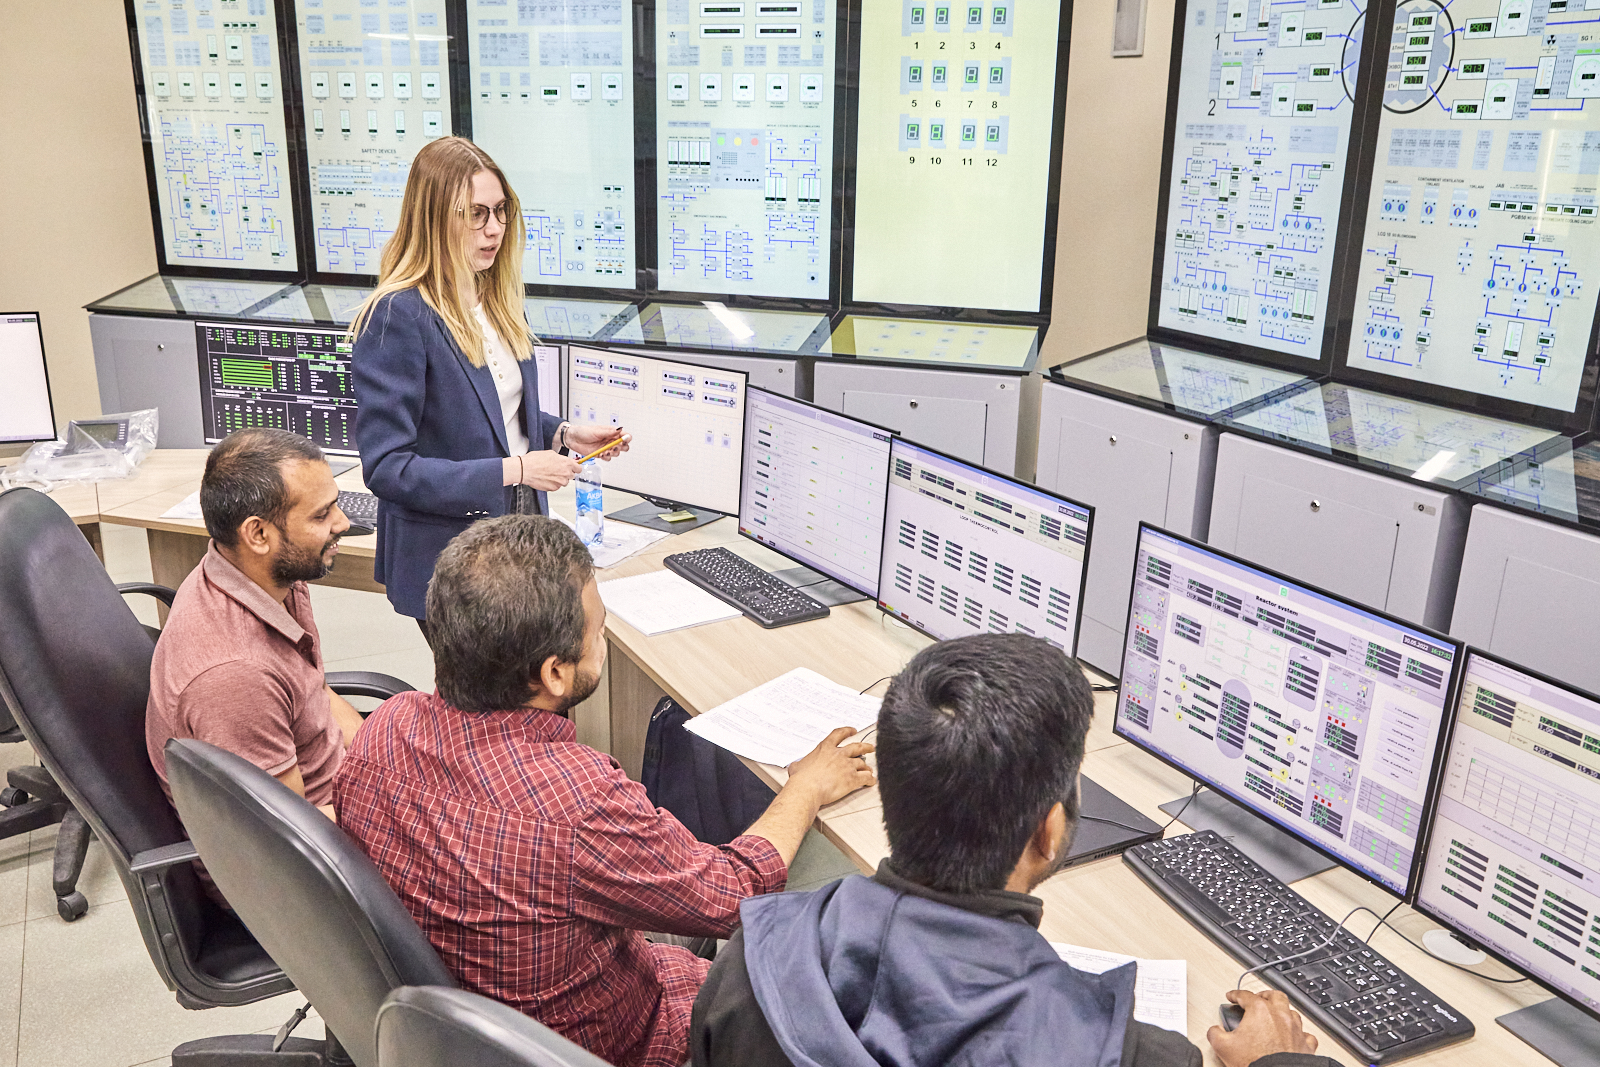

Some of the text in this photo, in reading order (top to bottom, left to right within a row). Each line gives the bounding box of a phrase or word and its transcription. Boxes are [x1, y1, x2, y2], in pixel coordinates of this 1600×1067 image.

[914, 42, 1001, 50] 1 2 3 4
[1215, 33, 1220, 50] 1
[992, 101, 998, 109] 8
[1208, 99, 1216, 116] 2
[930, 157, 941, 165] 10
[1256, 595, 1277, 607] Reactor
[1404, 636, 1428, 651] 30.05.2022
